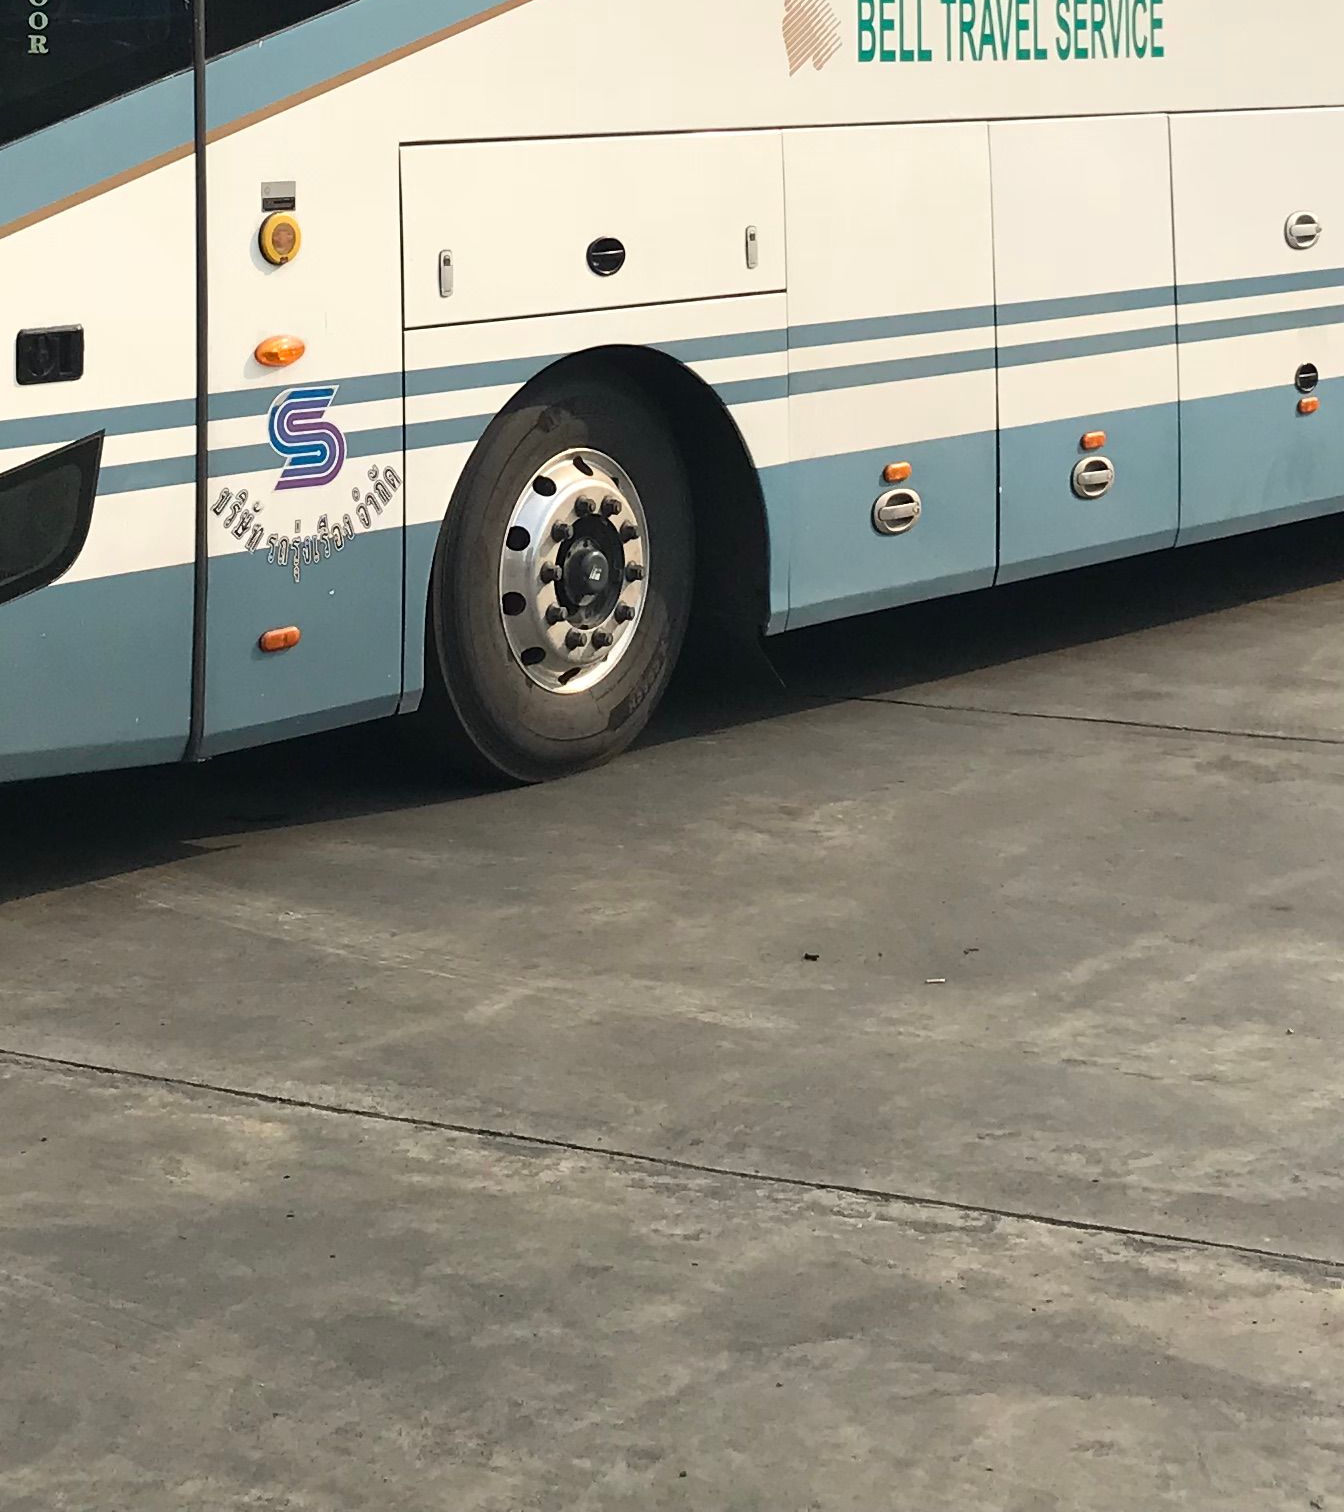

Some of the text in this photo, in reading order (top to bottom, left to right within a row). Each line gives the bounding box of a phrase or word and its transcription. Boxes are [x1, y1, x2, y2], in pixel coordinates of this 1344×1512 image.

[210, 463, 403, 583] บริษัท รถรุ่งเรือง จำกัด
